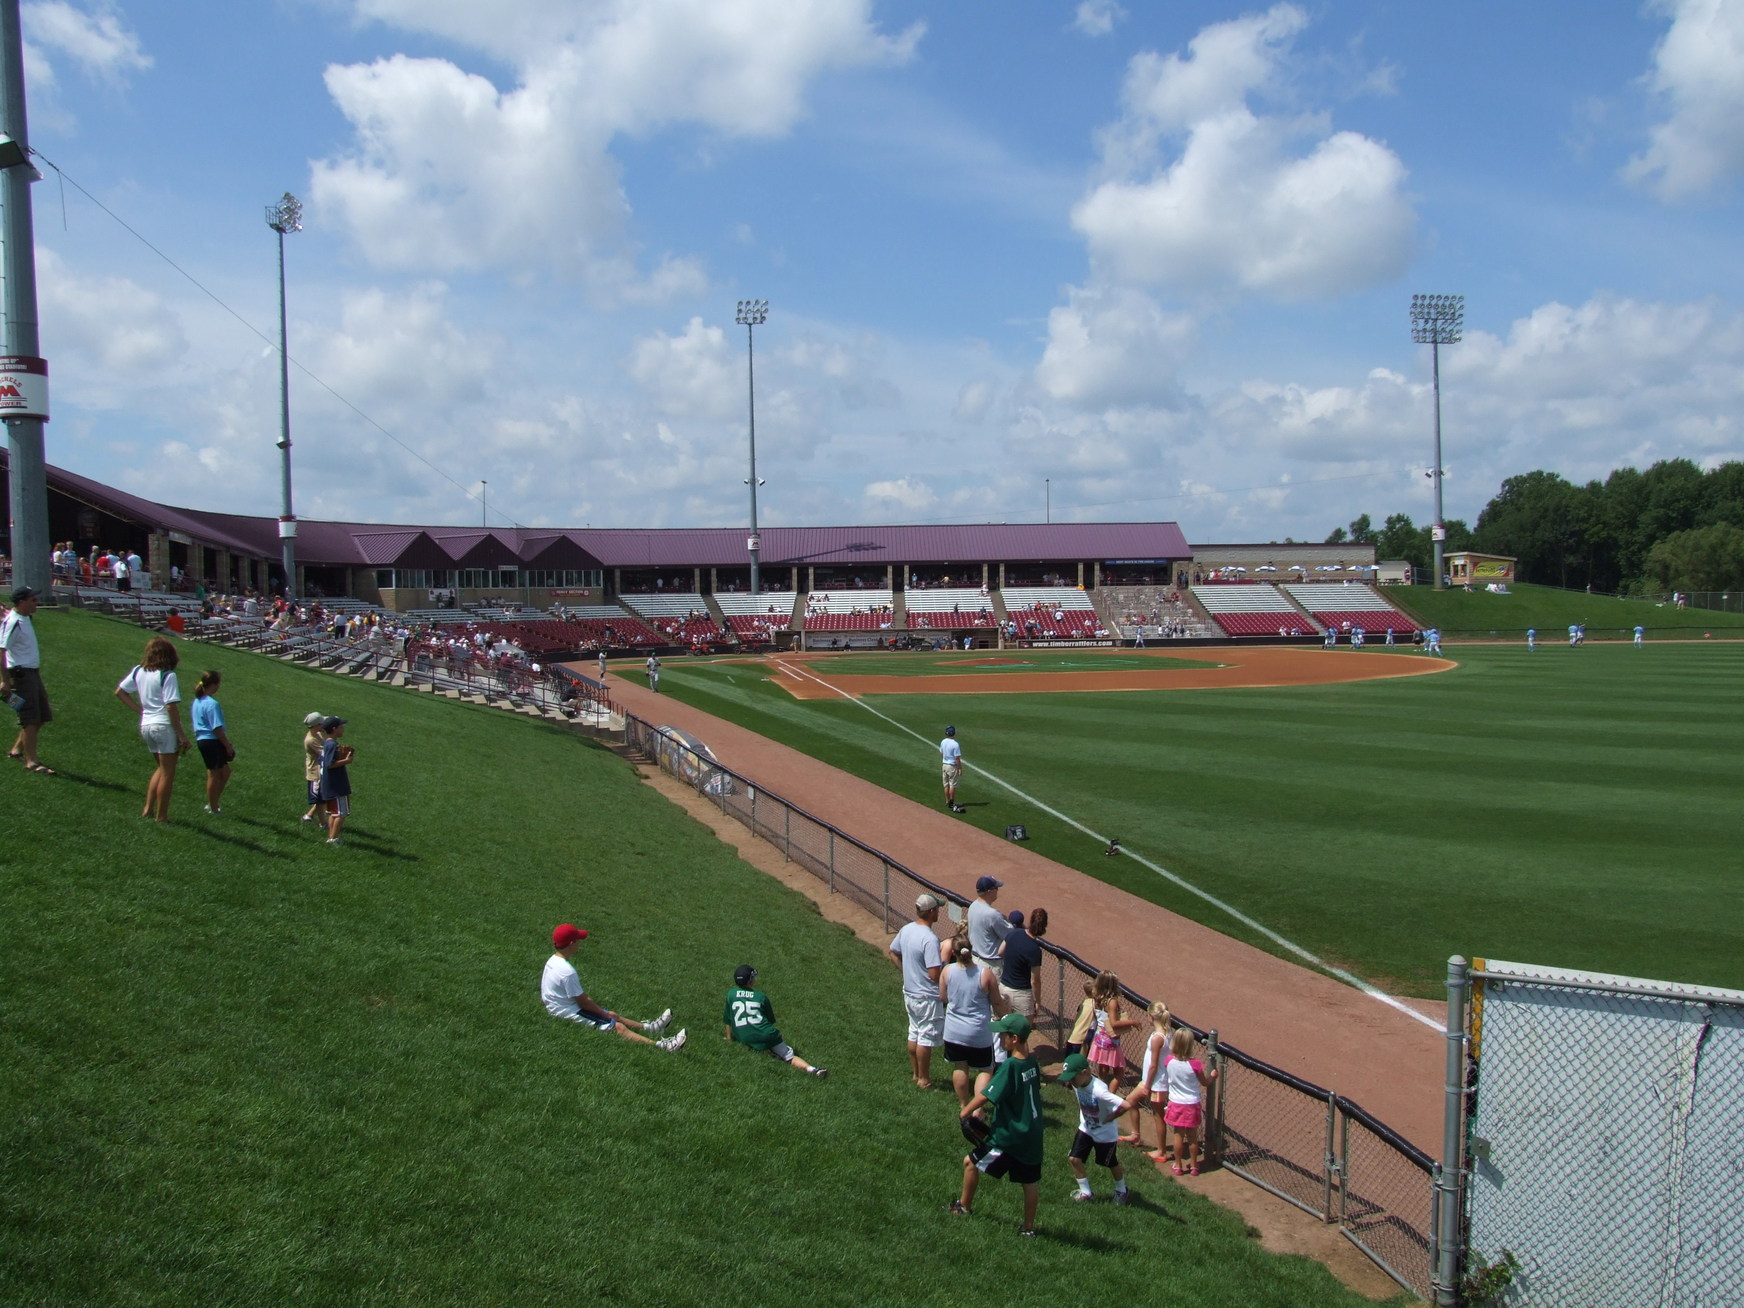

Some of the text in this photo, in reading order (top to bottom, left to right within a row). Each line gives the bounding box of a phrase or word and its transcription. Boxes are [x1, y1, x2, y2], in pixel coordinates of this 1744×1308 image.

[1032, 640, 1113, 648] www.timberrattlers.com
[736, 990, 754, 998] KRUG
[732, 1000, 763, 1027] 25
